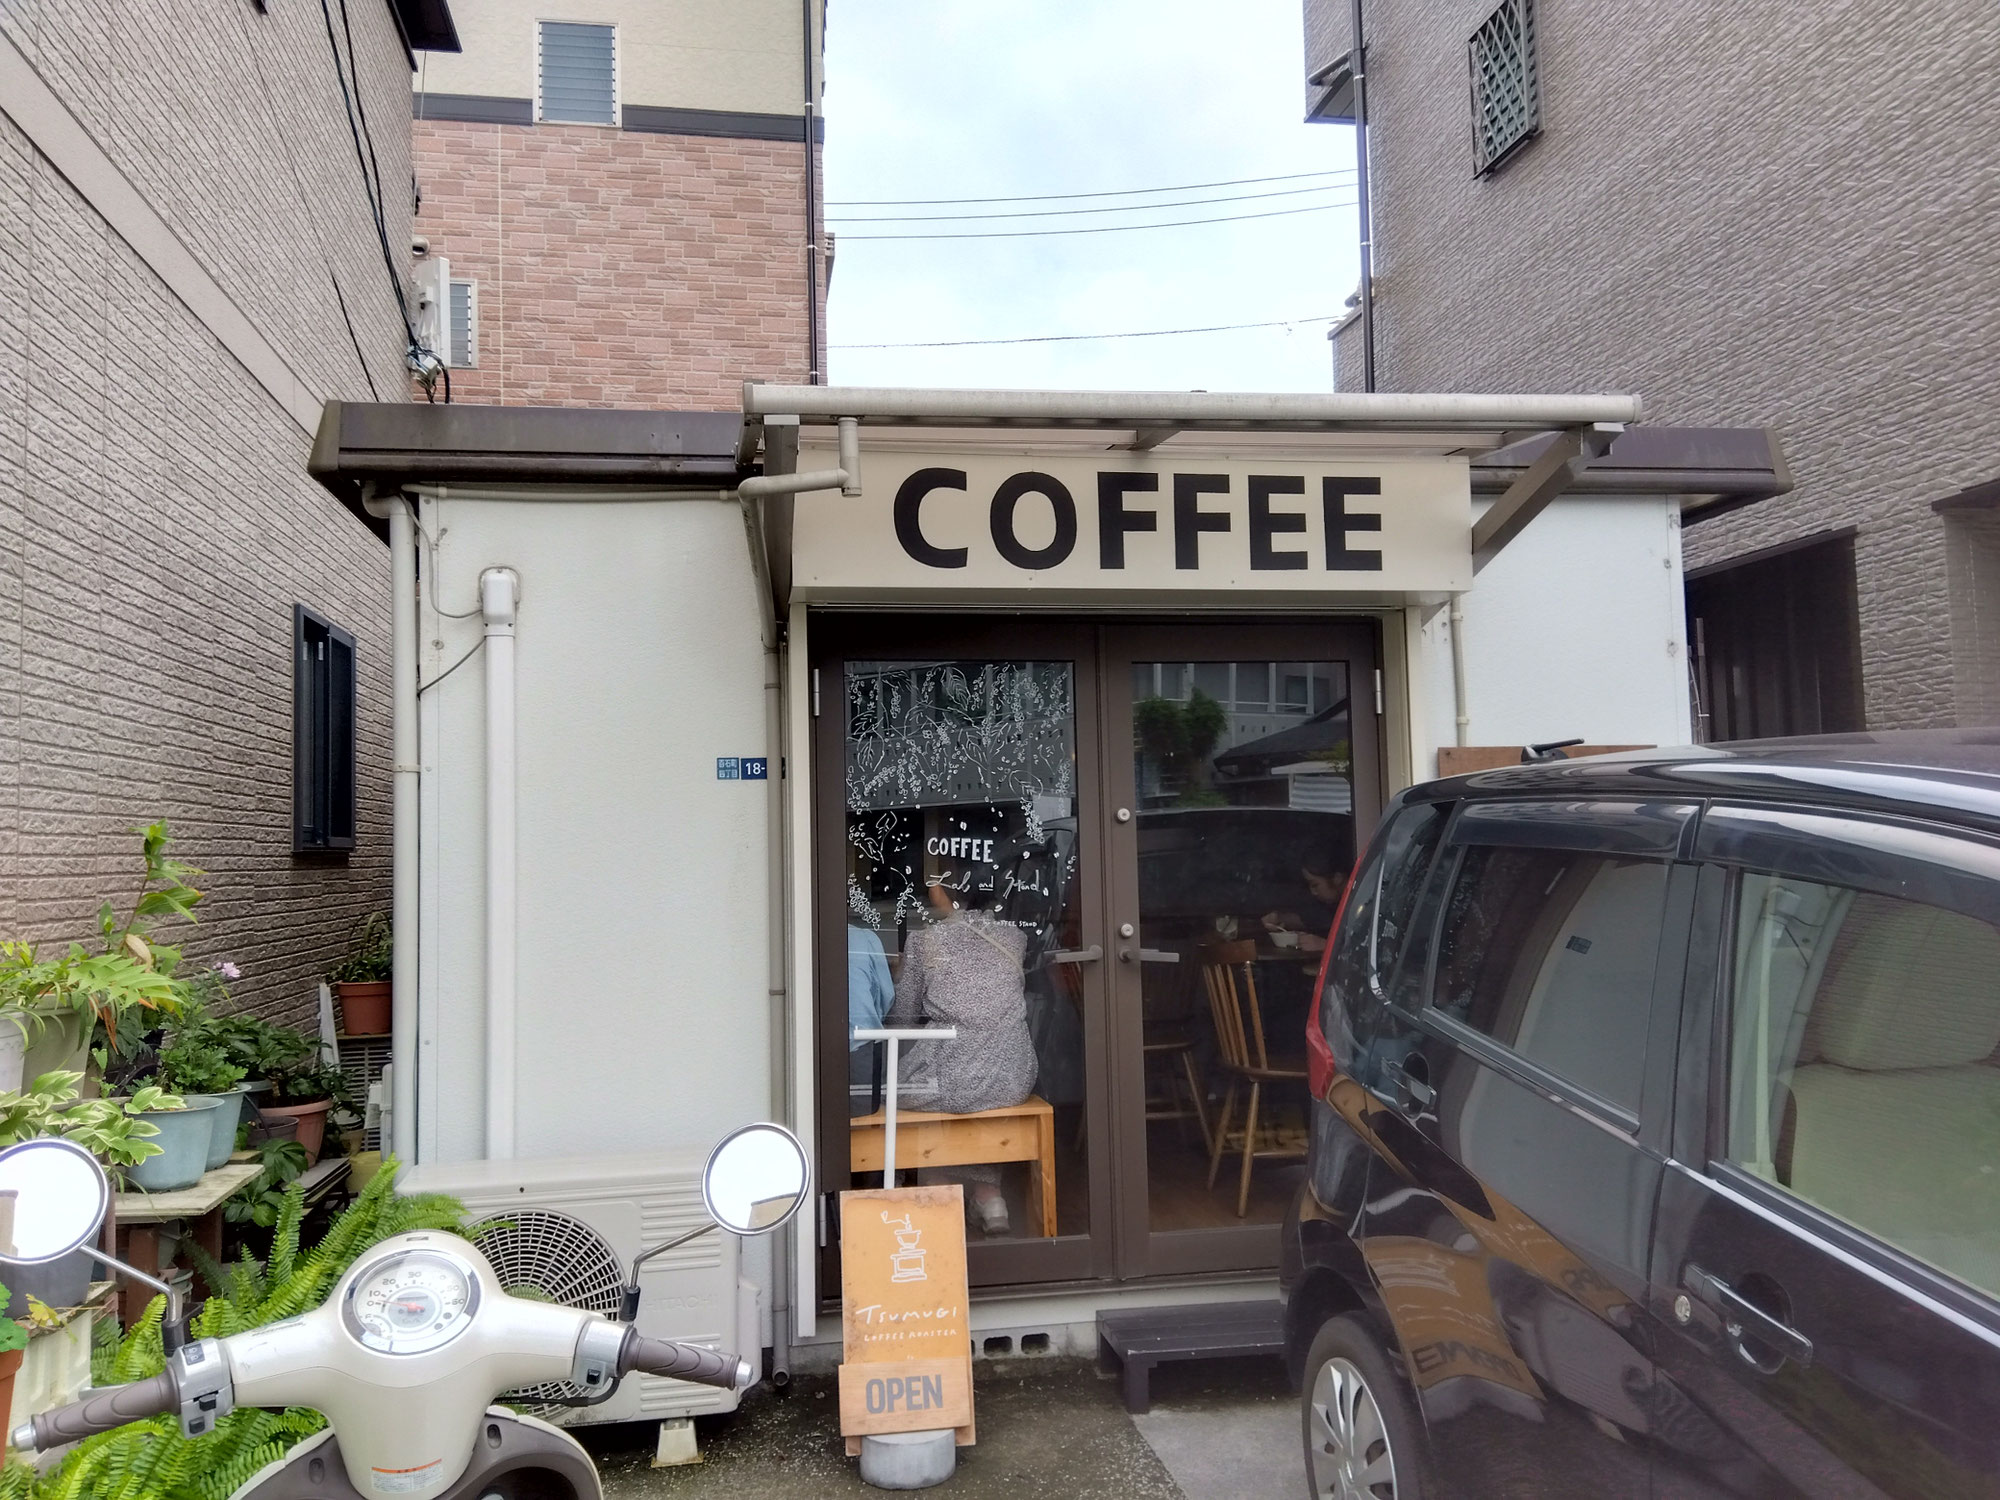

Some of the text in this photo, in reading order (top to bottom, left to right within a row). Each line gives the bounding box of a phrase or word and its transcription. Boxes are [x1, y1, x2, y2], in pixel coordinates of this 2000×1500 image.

[892, 466, 1383, 571] COFFEE
[745, 762, 766, 775] 18-
[927, 837, 994, 863] COFFEE
[925, 869, 1041, 900] Lab and Stand
[382, 1278, 396, 1286] 20
[369, 1290, 381, 1298] 10
[864, 1329, 958, 1342] COFFEE ROASTER
[865, 1373, 944, 1415] OPEN
